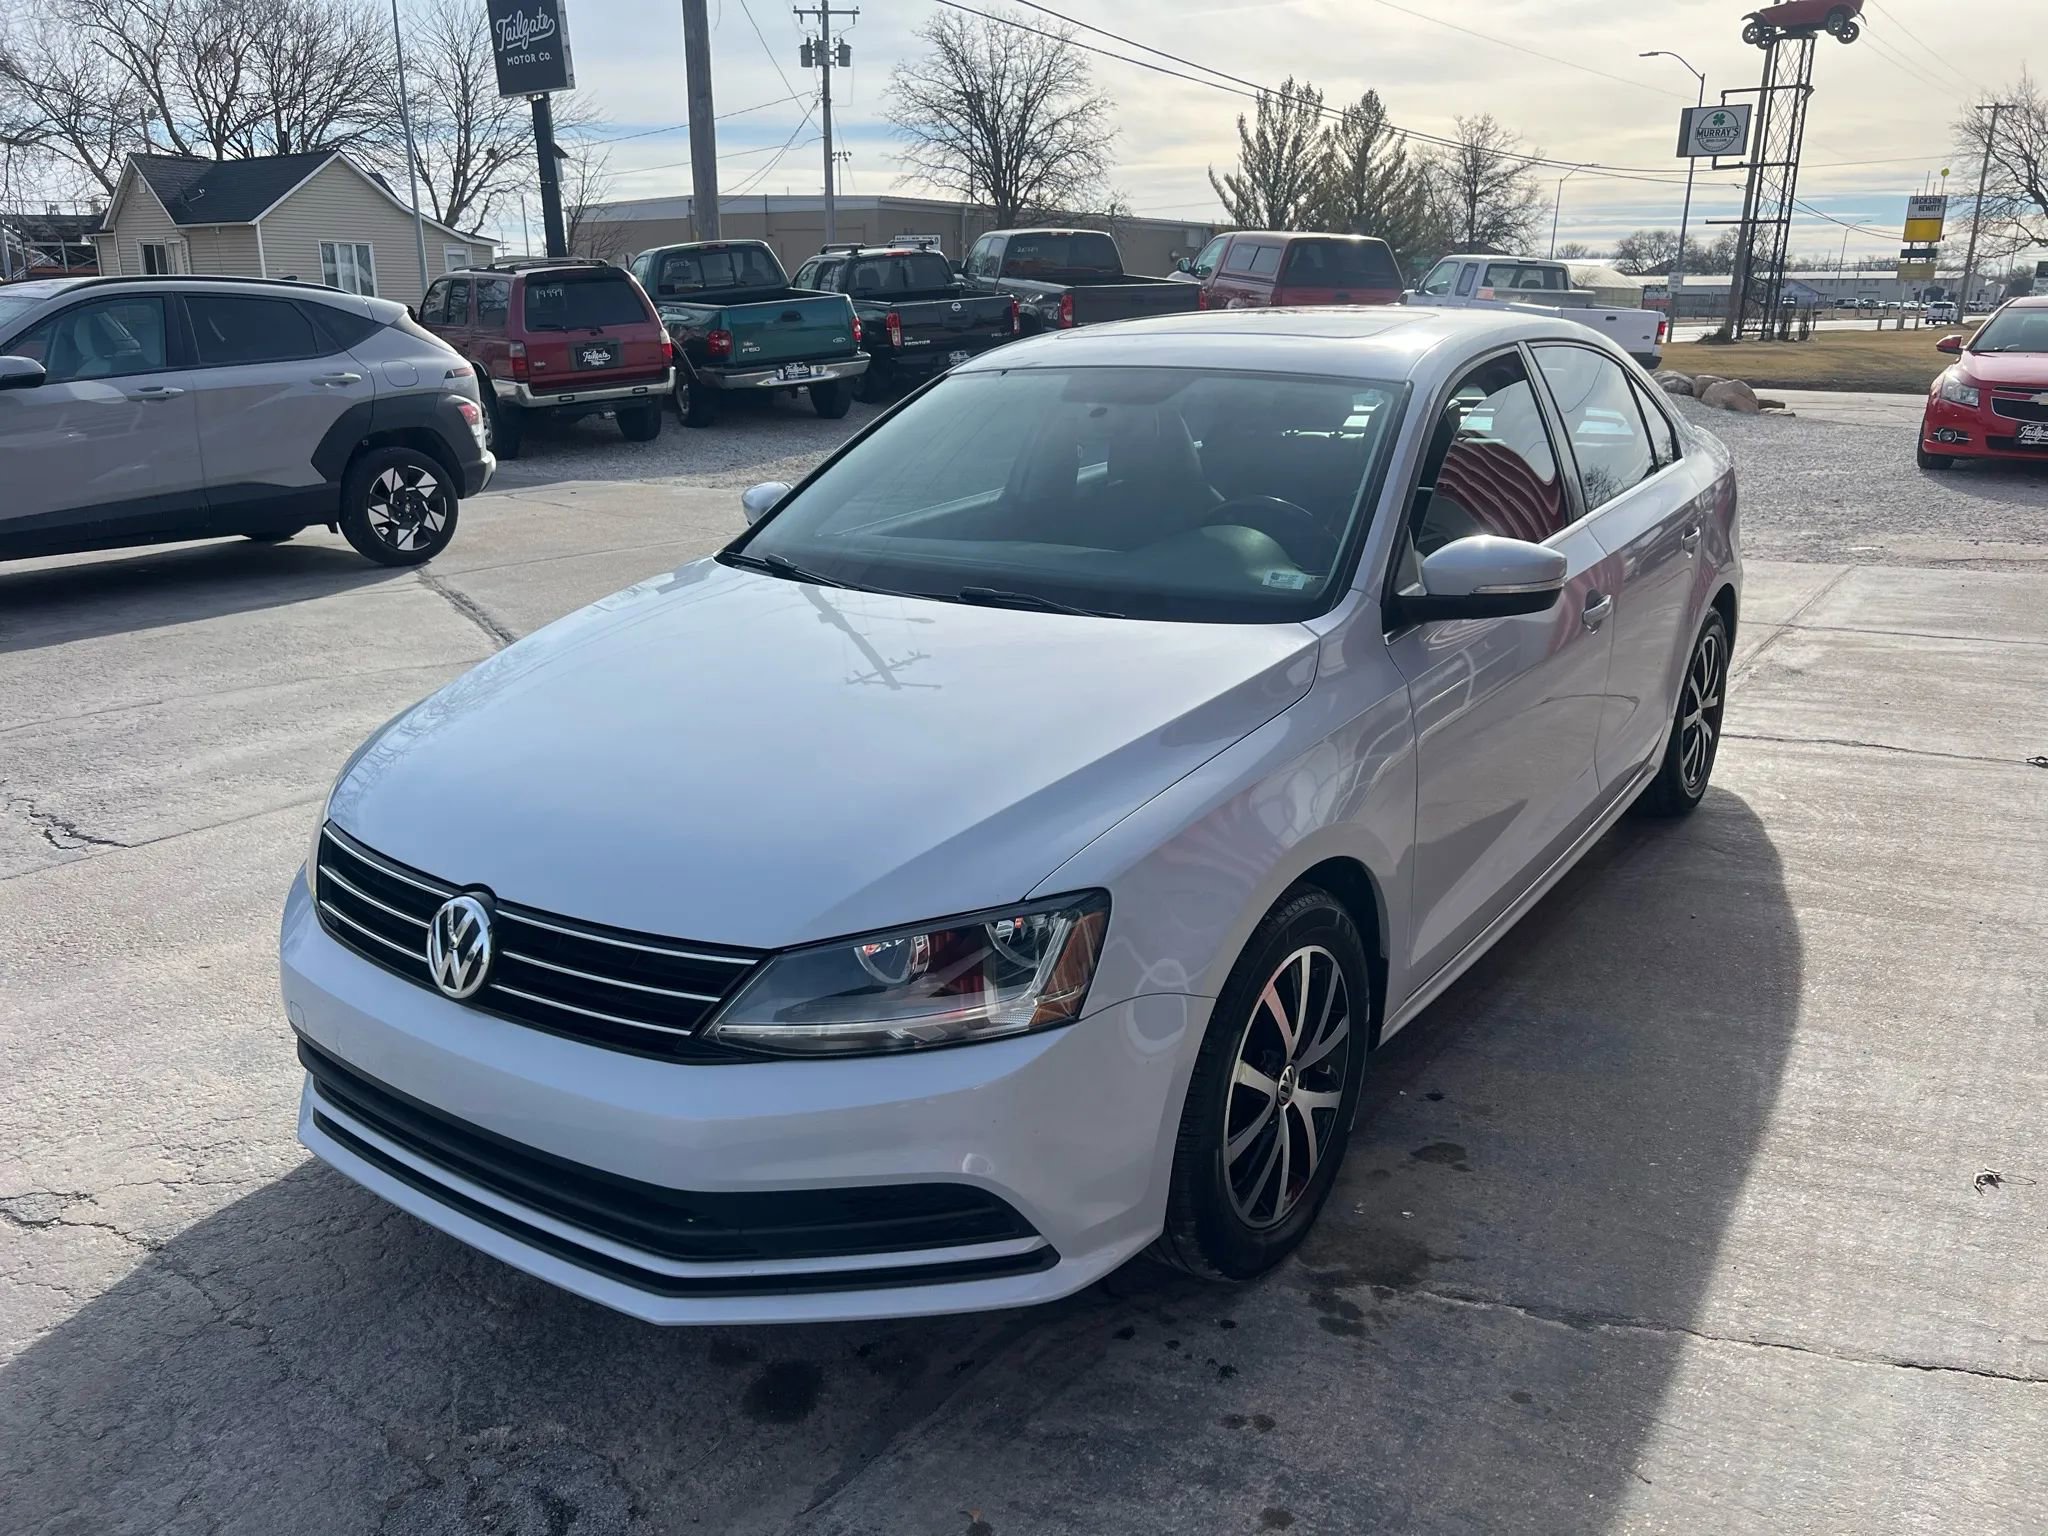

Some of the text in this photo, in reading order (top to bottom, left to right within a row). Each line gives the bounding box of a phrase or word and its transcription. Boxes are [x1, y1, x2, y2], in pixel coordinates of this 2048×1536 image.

[496, 6, 555, 52] Tailgate
[506, 53, 536, 66] MOTOR
[1696, 127, 1739, 138] MURRAY'S
